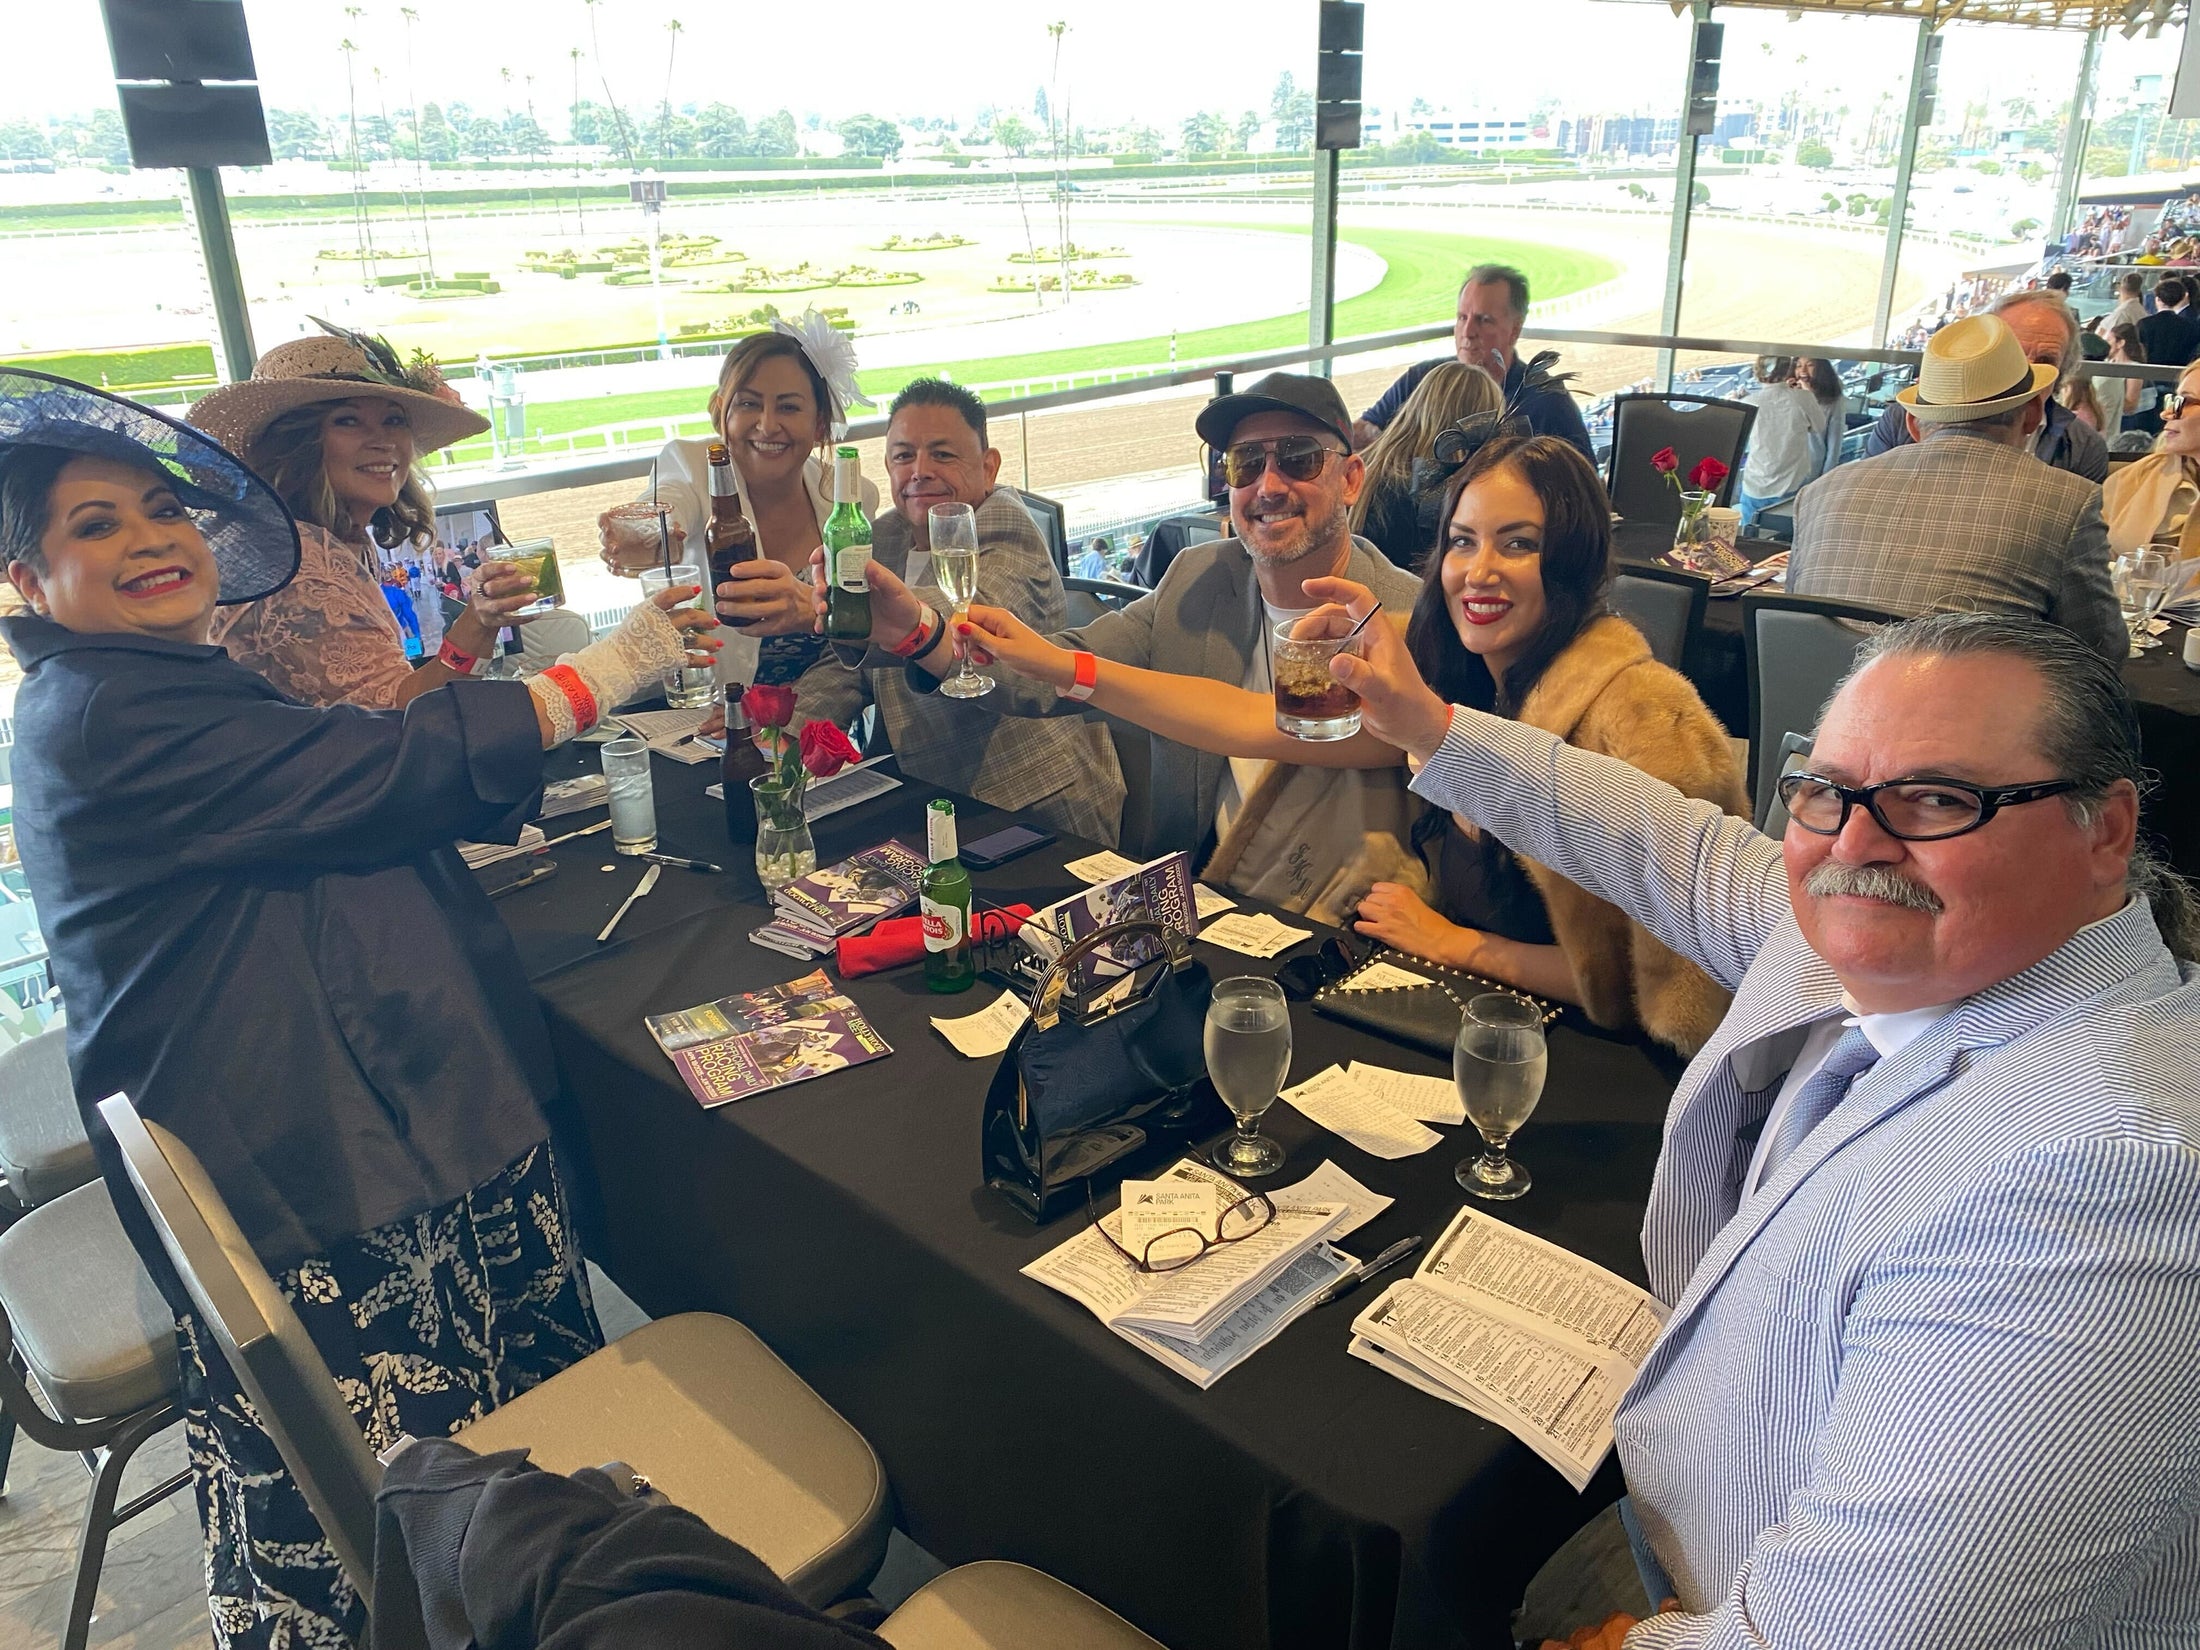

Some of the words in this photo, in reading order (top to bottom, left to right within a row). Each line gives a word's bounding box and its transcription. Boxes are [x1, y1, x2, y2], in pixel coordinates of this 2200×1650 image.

[1149, 877, 1159, 903] DAILY
[1159, 888, 1174, 927] CING
[922, 917, 943, 928] TELLA
[922, 925, 943, 935] RTOIS
[855, 1017, 885, 1052] HOLLYWOOD
[710, 1043, 742, 1083] RACING
[724, 1041, 748, 1071] OFFICIAL
[741, 1070, 759, 1087] DAILY
[695, 1047, 735, 1096] PROGRAM
[1155, 1192, 1179, 1200] SANTA
[1179, 1192, 1200, 1200] ANITA
[1193, 1168, 1216, 1184] SANTA
[1215, 1179, 1238, 1194] ANITA
[1236, 1190, 1260, 1212] PRK
[1434, 1261, 1450, 1275] 13
[1381, 1315, 1398, 1328] 11
[1474, 1374, 1484, 1383] 16
[1488, 1383, 1497, 1392] 17
[1505, 1395, 1515, 1404] 18
[1520, 1406, 1529, 1415] 19
[1533, 1416, 1543, 1425] 20
[1549, 1428, 1559, 1438] 21
